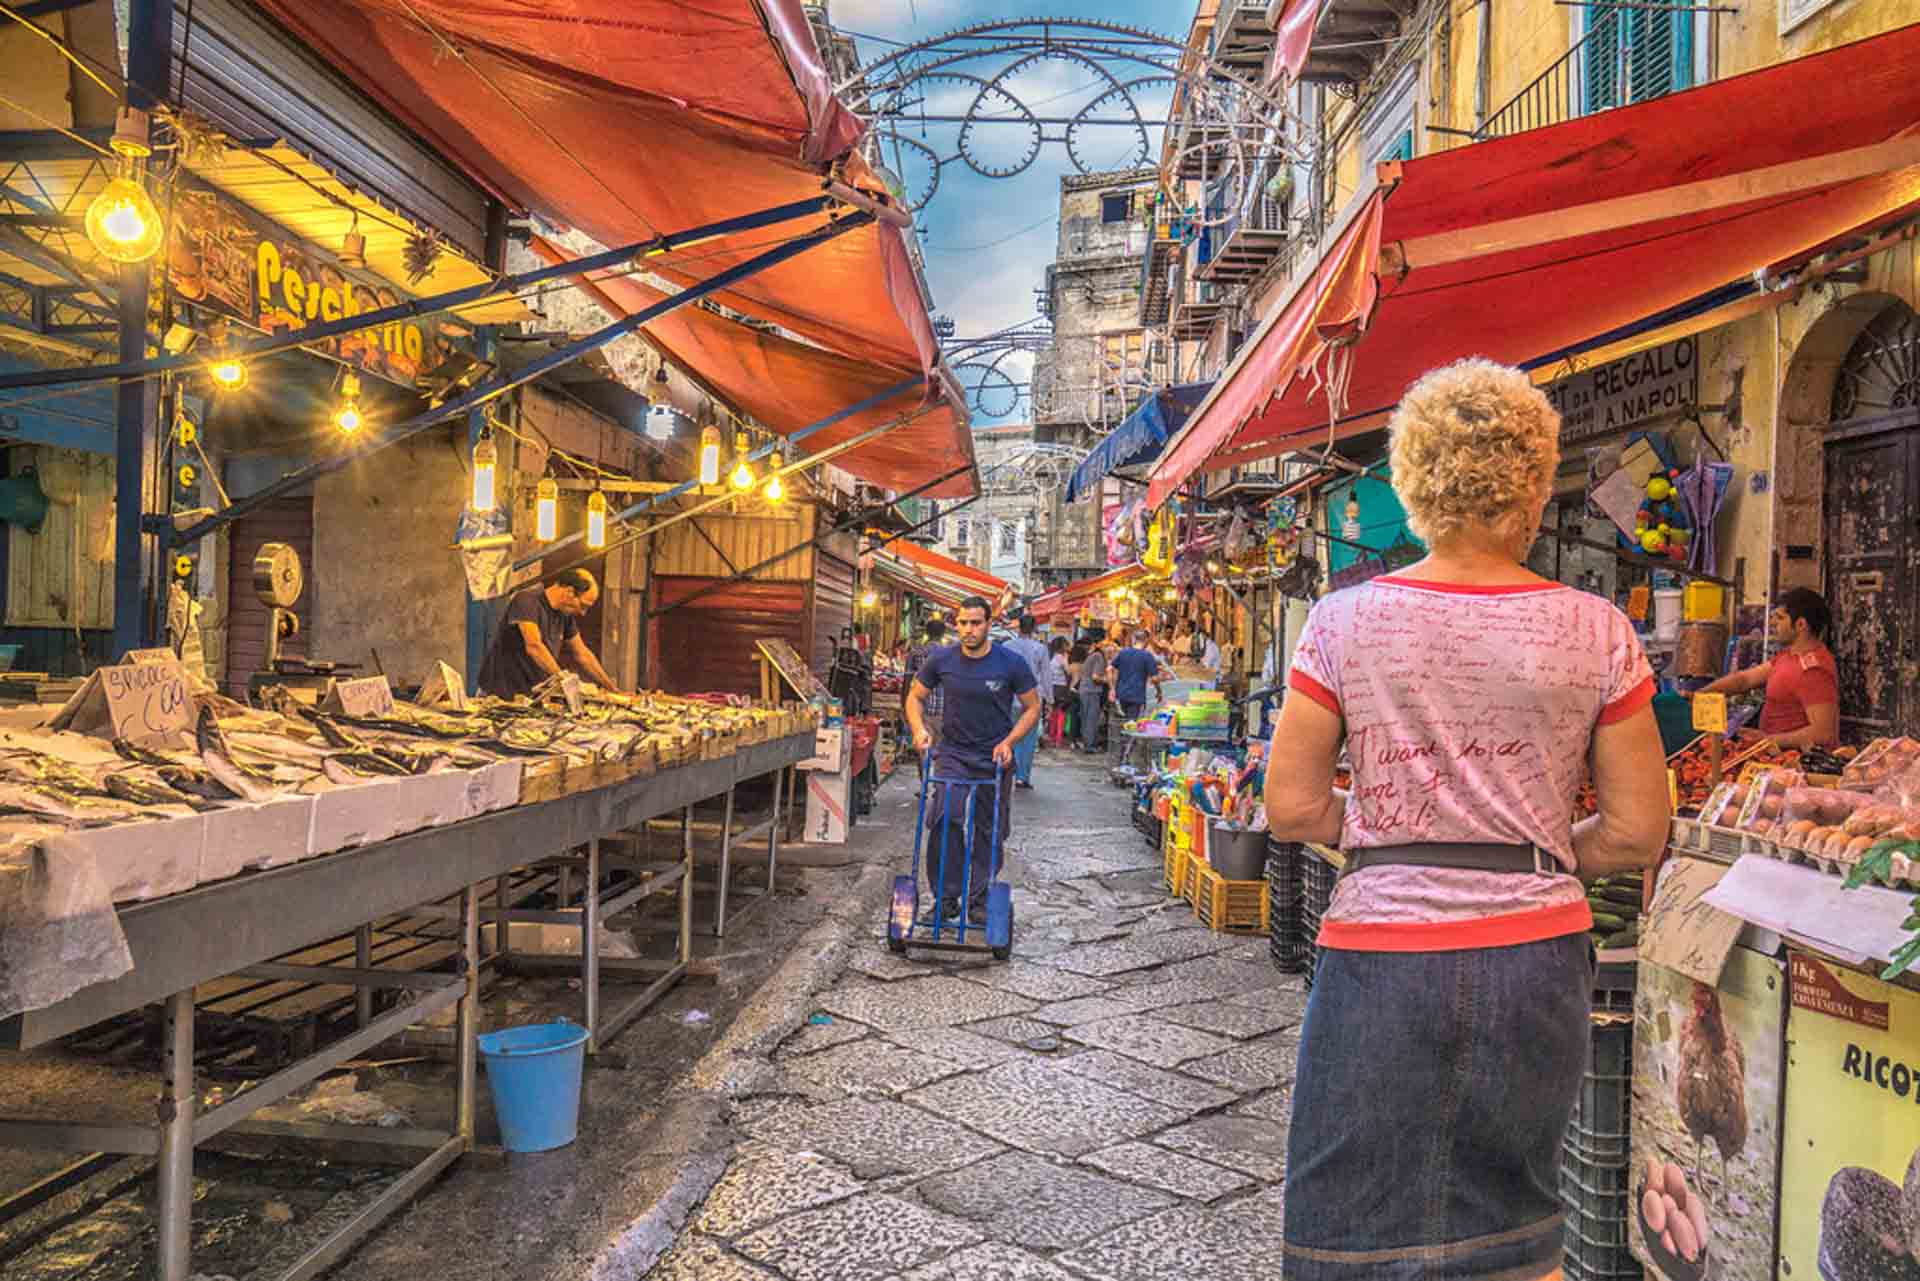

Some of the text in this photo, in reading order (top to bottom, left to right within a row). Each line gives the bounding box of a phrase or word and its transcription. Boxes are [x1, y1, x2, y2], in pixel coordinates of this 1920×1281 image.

[1594, 338, 1693, 399] REGALO
[1605, 408, 1616, 427] A
[1622, 380, 1695, 423] NAPOLI
[1378, 741, 1440, 766] want
